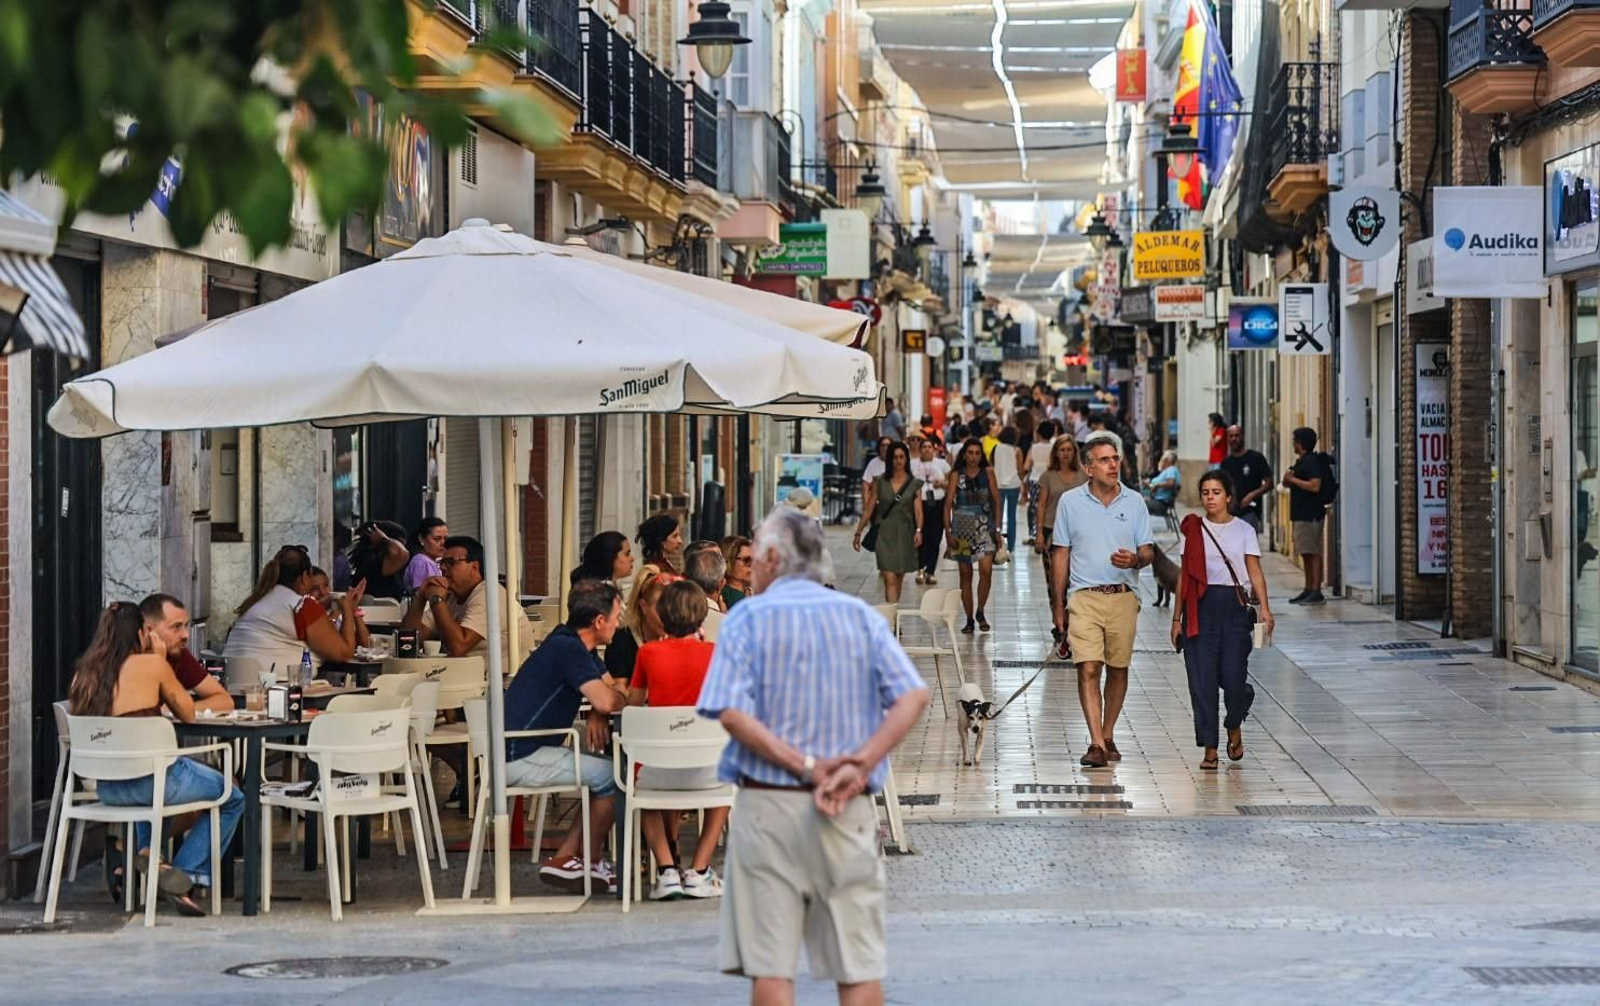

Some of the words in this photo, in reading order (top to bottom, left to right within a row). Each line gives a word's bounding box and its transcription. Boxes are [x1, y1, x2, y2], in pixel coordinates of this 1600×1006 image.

[1136, 235, 1200, 254] ALDEMAR
[1469, 233, 1539, 249] Audika
[1137, 259, 1200, 274] PELUQUEROS
[599, 369, 669, 406] SanMiguel
[1420, 403, 1446, 415] VACIA
[1420, 416, 1447, 428] ALMAC
[1423, 480, 1447, 499] 16
